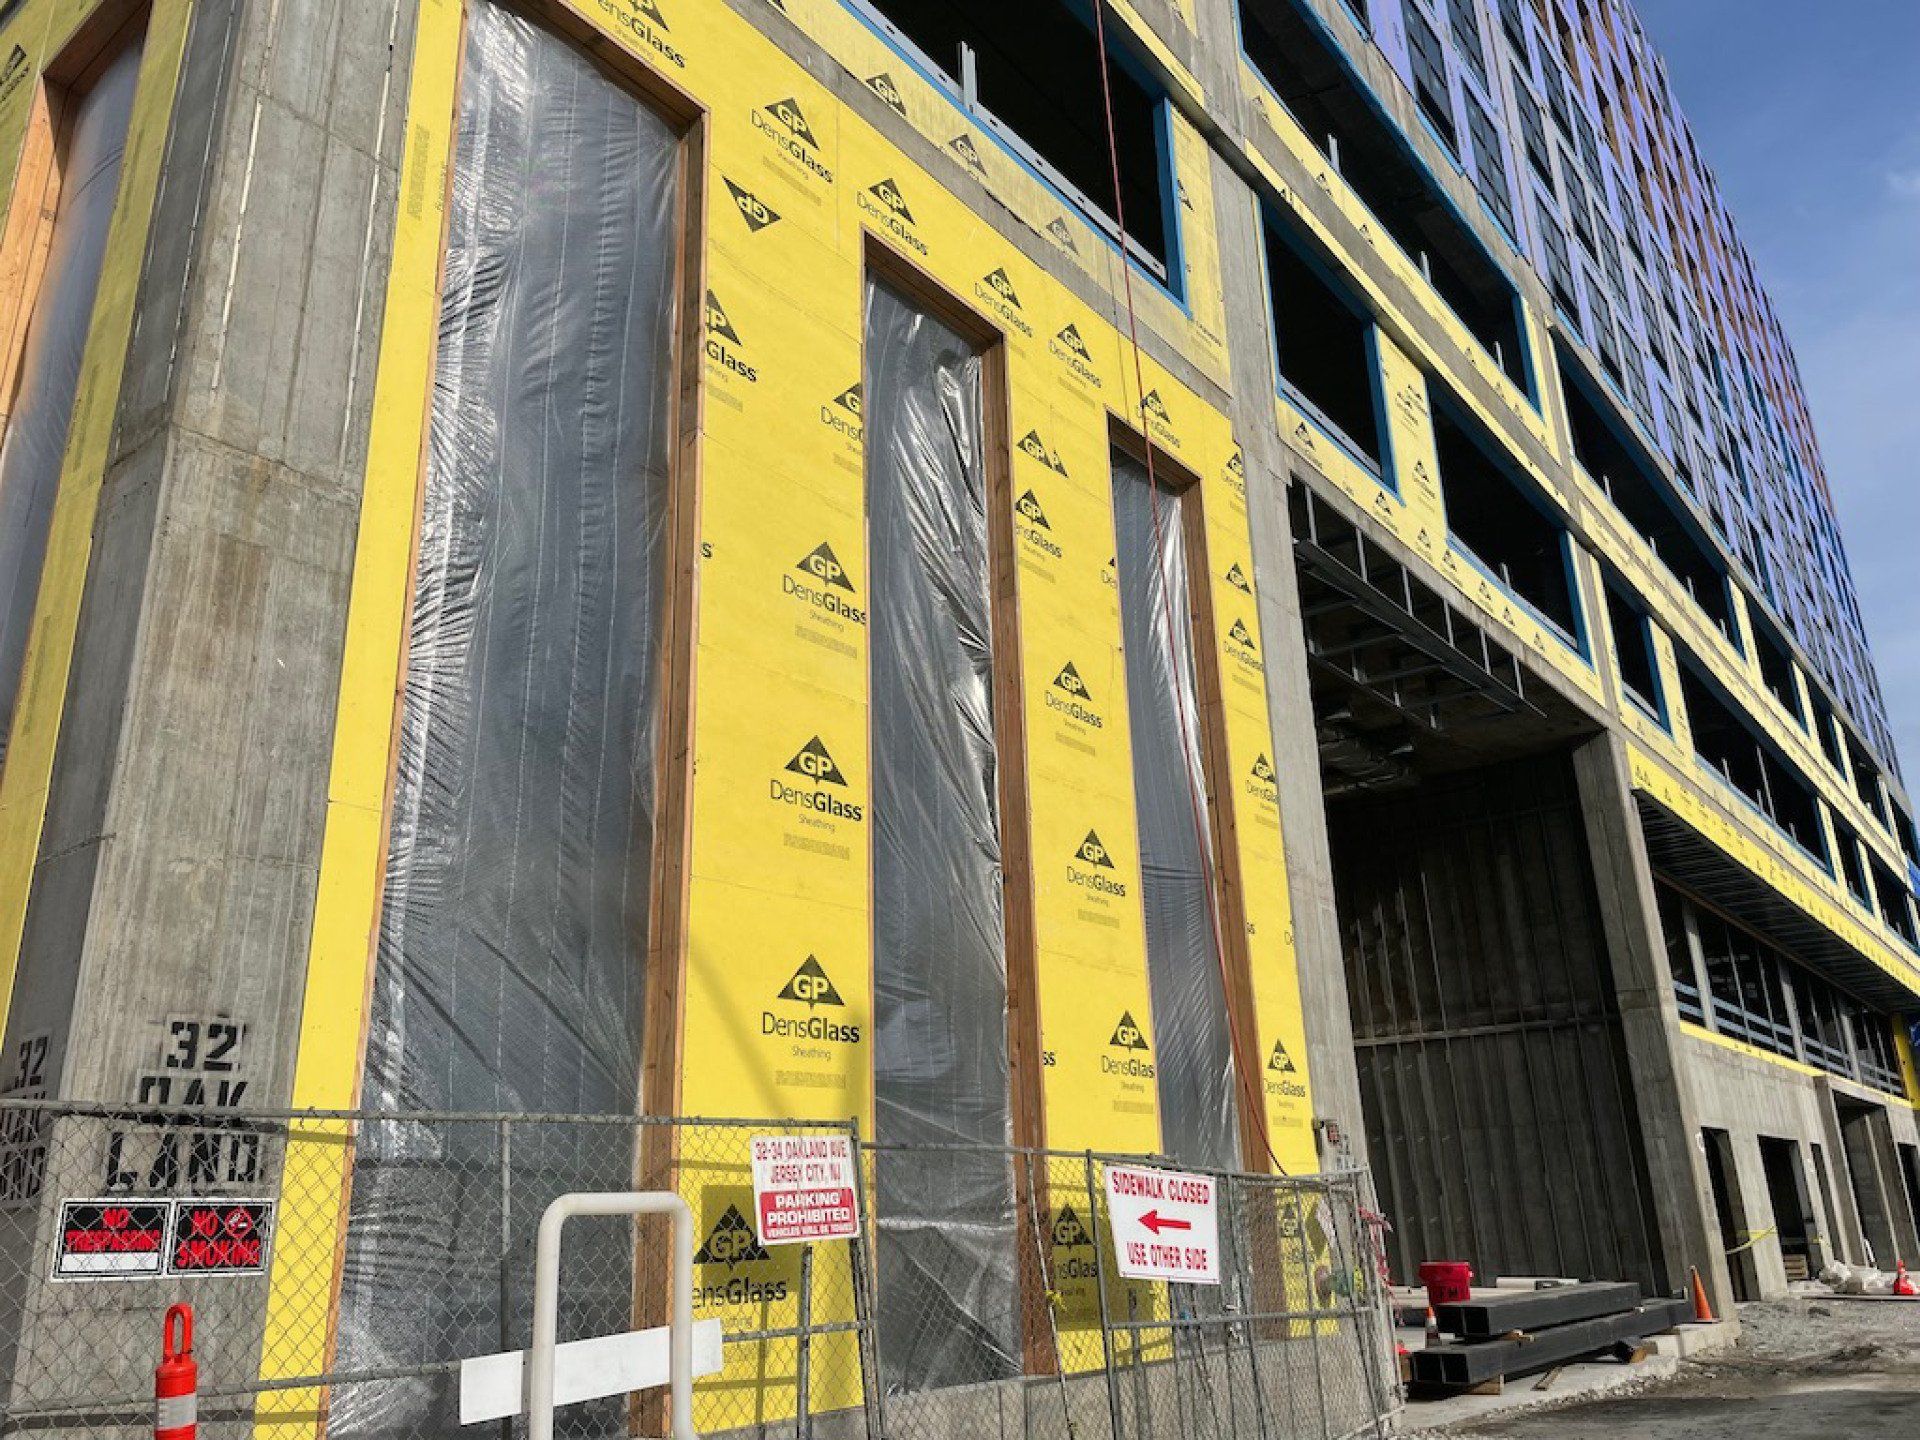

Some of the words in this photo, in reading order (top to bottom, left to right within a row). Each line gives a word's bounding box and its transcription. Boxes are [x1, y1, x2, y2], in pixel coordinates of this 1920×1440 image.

[597, 0, 685, 68] ensGlass
[751, 108, 833, 184] DensGlass
[857, 190, 928, 256] DensGlass
[783, 573, 867, 625] DensGlass
[1044, 689, 1103, 729] DensGlass
[770, 779, 863, 822] DensGlass
[1066, 865, 1126, 897] DensGlass
[792, 974, 830, 1000] GP
[762, 1011, 861, 1044] DensGlass
[15, 1035, 48, 1090] 32
[166, 1021, 238, 1072] 32
[106, 1131, 260, 1189] LAND
[785, 1140, 828, 1160] OAKLAND
[830, 1139, 847, 1158] AVE
[770, 1163, 802, 1184] JERSEY
[1111, 1170, 1165, 1200] SIDEWALK
[1167, 1179, 1211, 1206] CLOSED
[775, 1192, 841, 1209] PARKING
[102, 1207, 129, 1229] NO
[192, 1209, 219, 1237] NO
[766, 1207, 851, 1227] PROHIBITED
[175, 1239, 261, 1269] SMOKING
[709, 1229, 752, 1261] GP
[1126, 1241, 1149, 1267] USE
[1150, 1243, 1182, 1270] OTHER
[1184, 1245, 1209, 1272] SIDE
